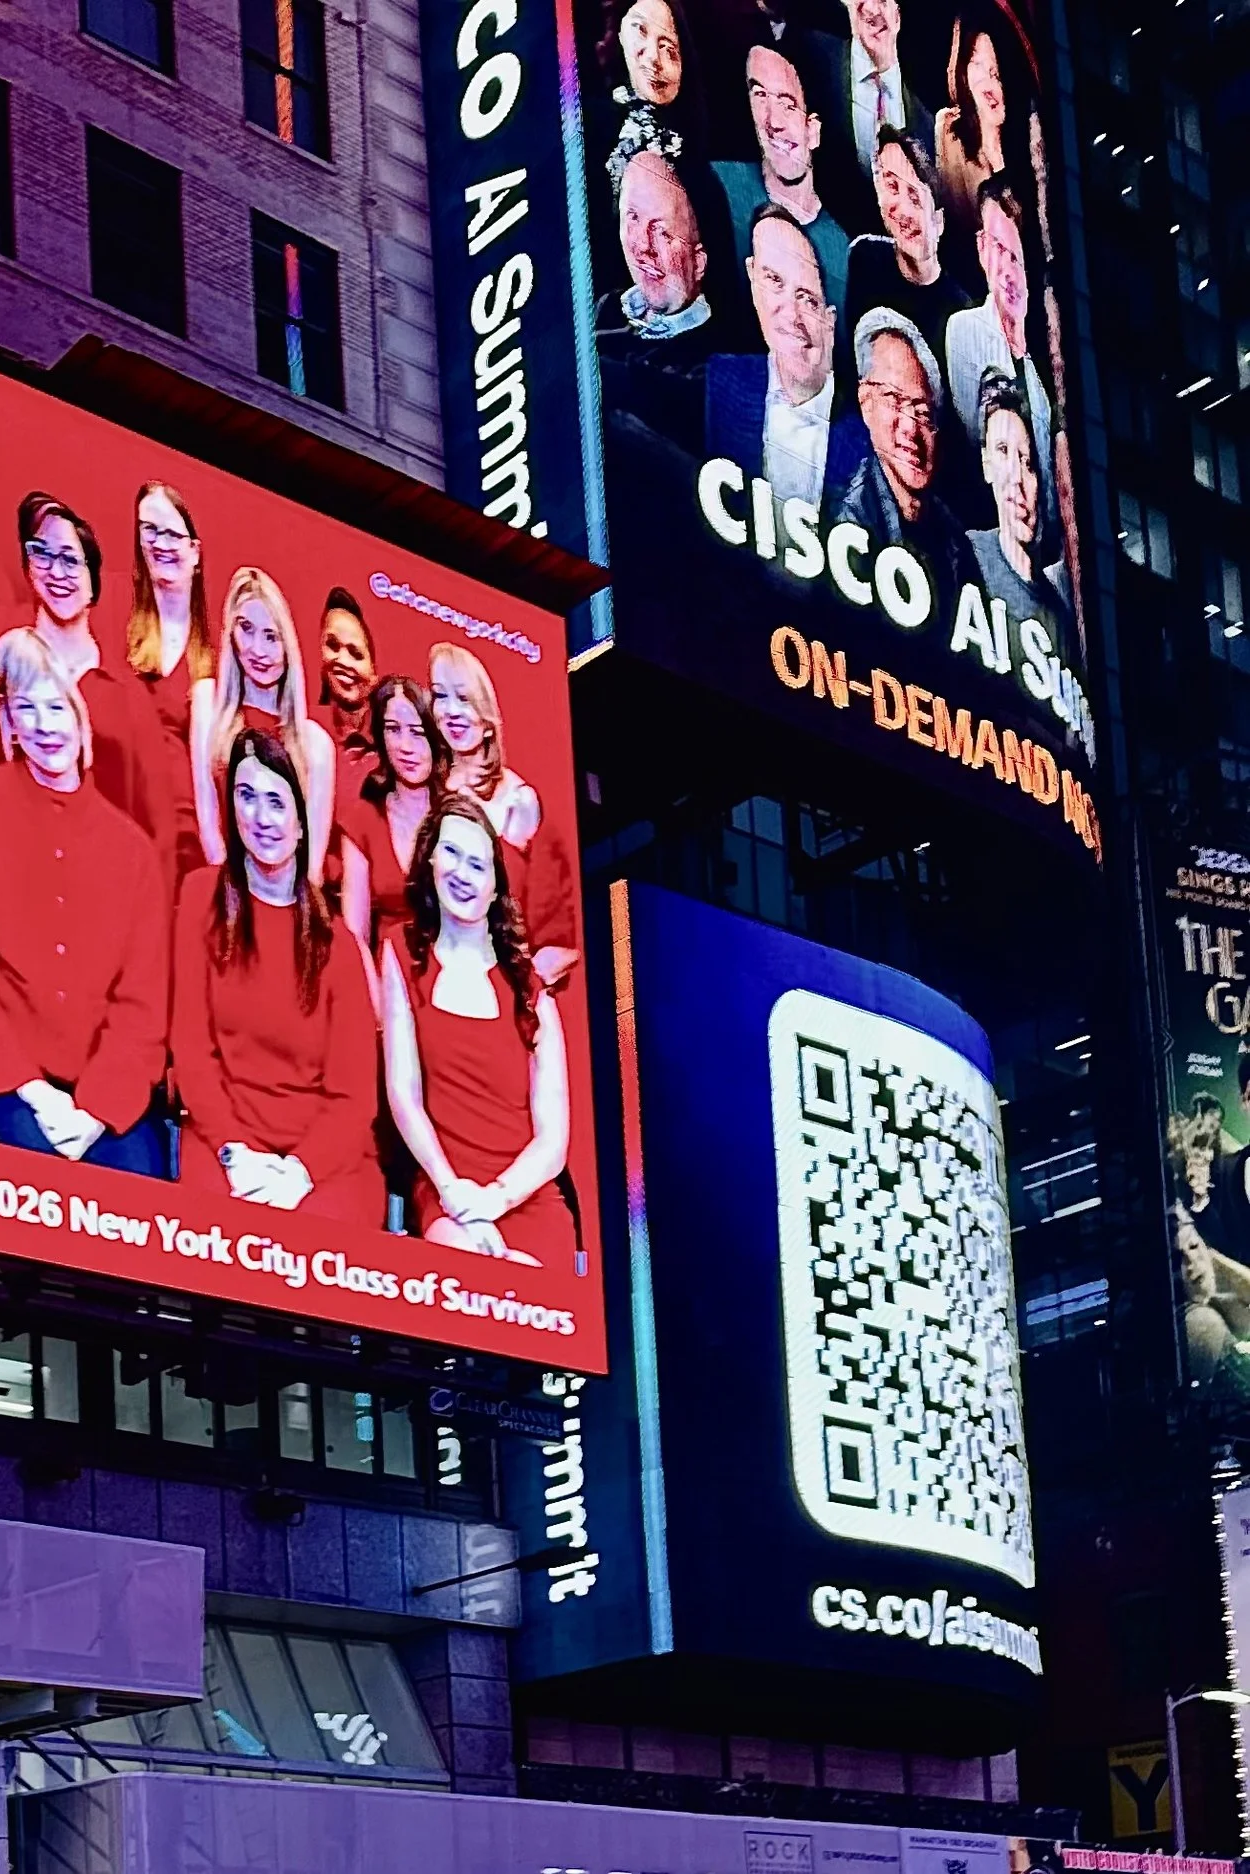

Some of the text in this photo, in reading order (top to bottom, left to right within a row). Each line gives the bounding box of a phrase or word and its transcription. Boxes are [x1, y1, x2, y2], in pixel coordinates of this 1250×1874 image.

[464, 168, 528, 256] AI
[698, 457, 932, 628] CISCO
[950, 582, 1011, 675] AI
[770, 625, 1060, 805] ON-DEMAND
[1175, 913, 1247, 981] THE
[68, 1195, 150, 1247] New
[154, 1214, 234, 1265] York
[236, 1235, 307, 1288] City
[310, 1250, 400, 1299] Class
[402, 1272, 440, 1306] of
[440, 1278, 576, 1336] Survivors
[748, 1839, 808, 1860] ROCK
